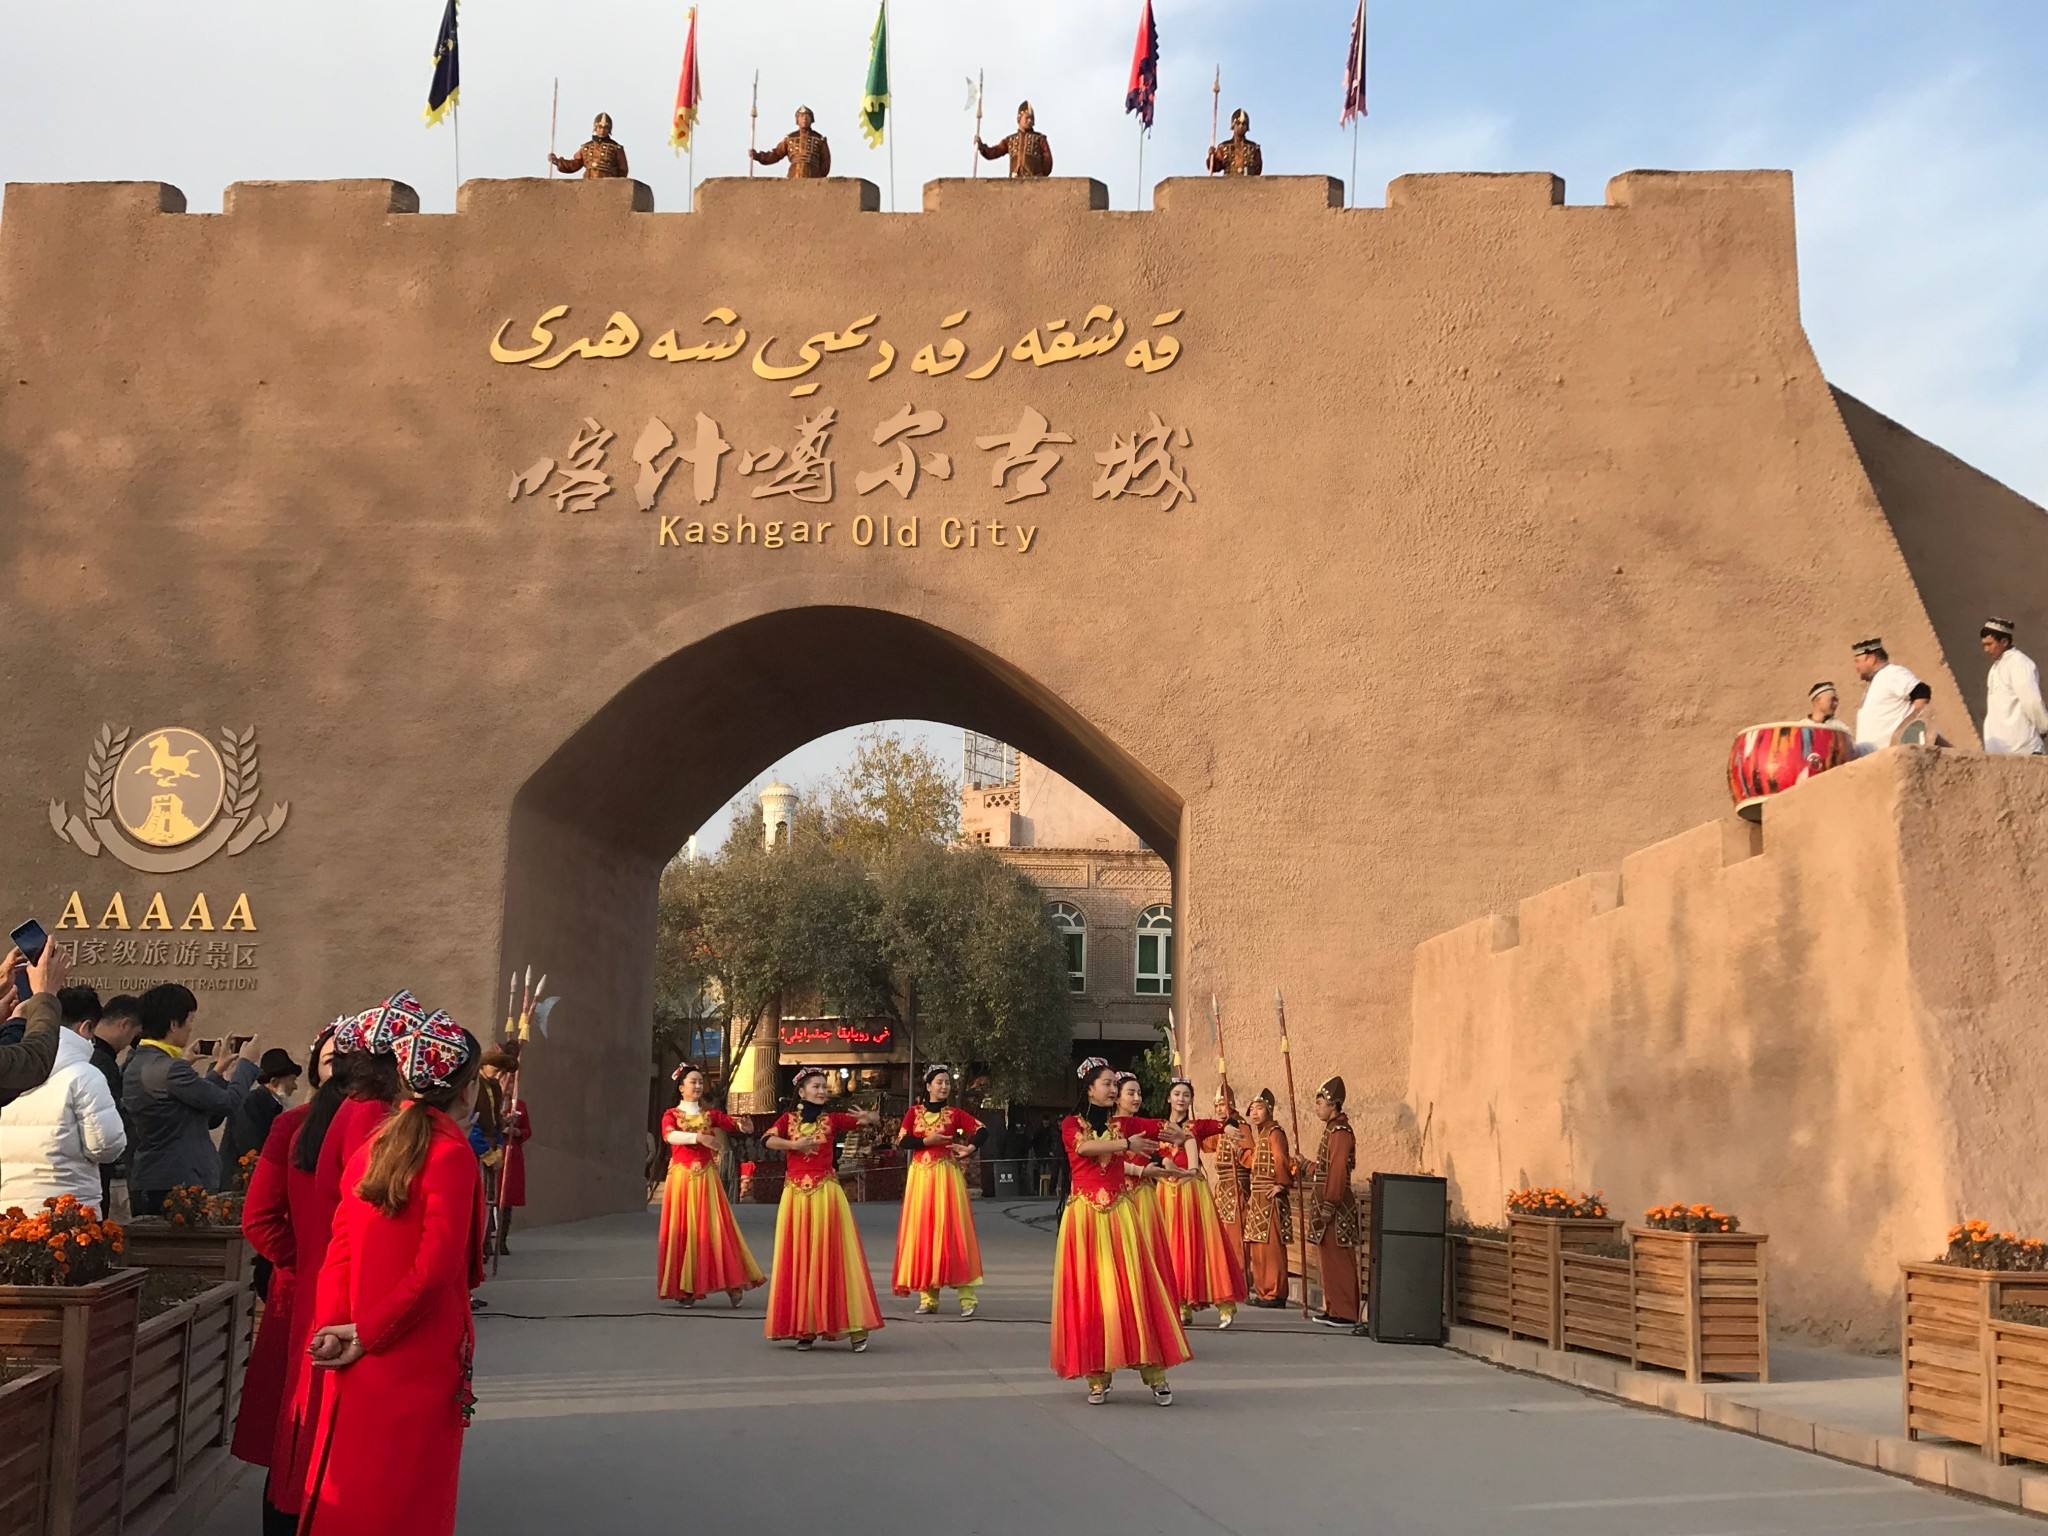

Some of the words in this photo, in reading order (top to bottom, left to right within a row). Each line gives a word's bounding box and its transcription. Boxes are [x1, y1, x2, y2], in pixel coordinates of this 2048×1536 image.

[658, 515, 832, 548] Kashgar
[851, 515, 918, 547] Old
[939, 517, 1037, 553] City
